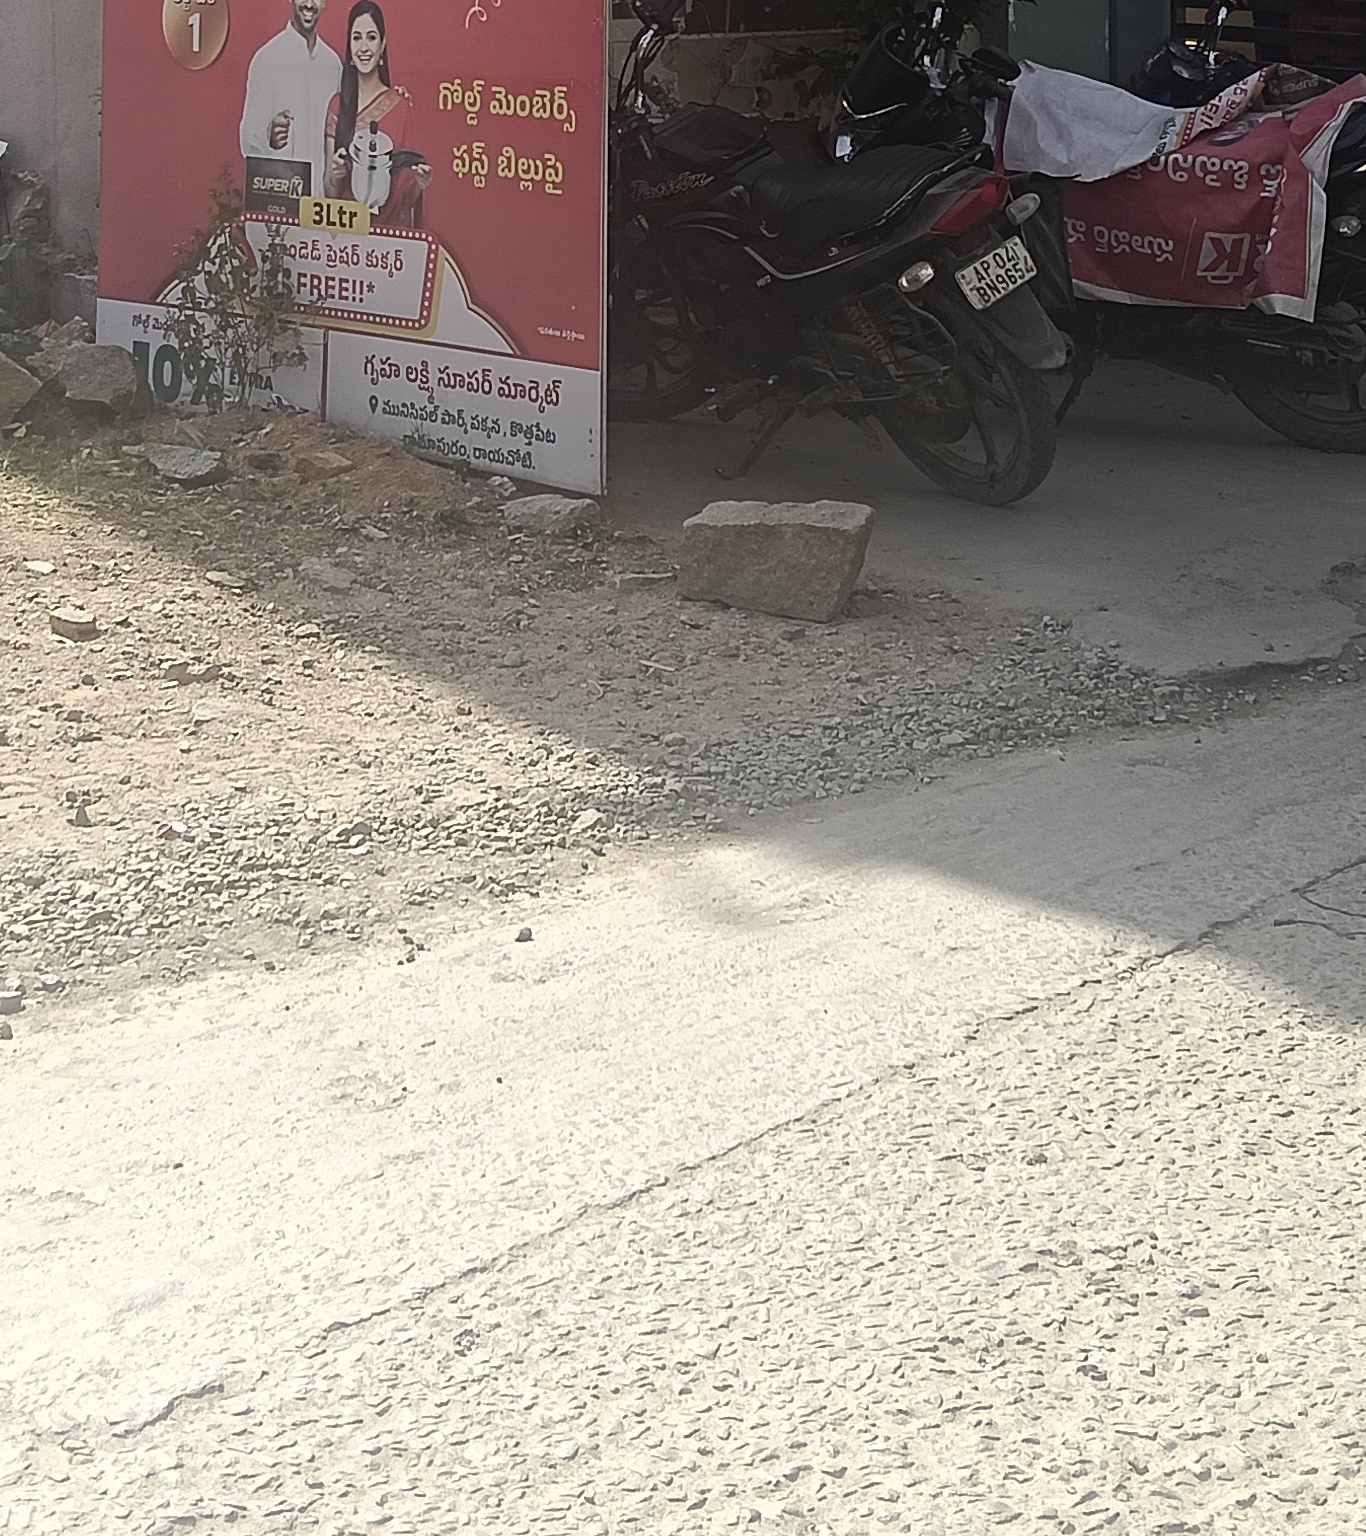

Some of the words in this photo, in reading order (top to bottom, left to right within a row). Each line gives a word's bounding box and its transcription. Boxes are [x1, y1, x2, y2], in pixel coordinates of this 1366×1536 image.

[188, 13, 201, 52] 1
[439, 79, 485, 125] గోల్డ్
[490, 86, 576, 132] మెంబెర్స్
[453, 142, 489, 188] ఫస్ట్
[498, 147, 563, 194] బిల్లుపై
[312, 202, 358, 229] 3Ltr
[976, 256, 1035, 303] BN9654
[363, 354, 401, 386] గృహ
[437, 365, 493, 396] సూపర్
[497, 375, 563, 414] మార్కెట్
